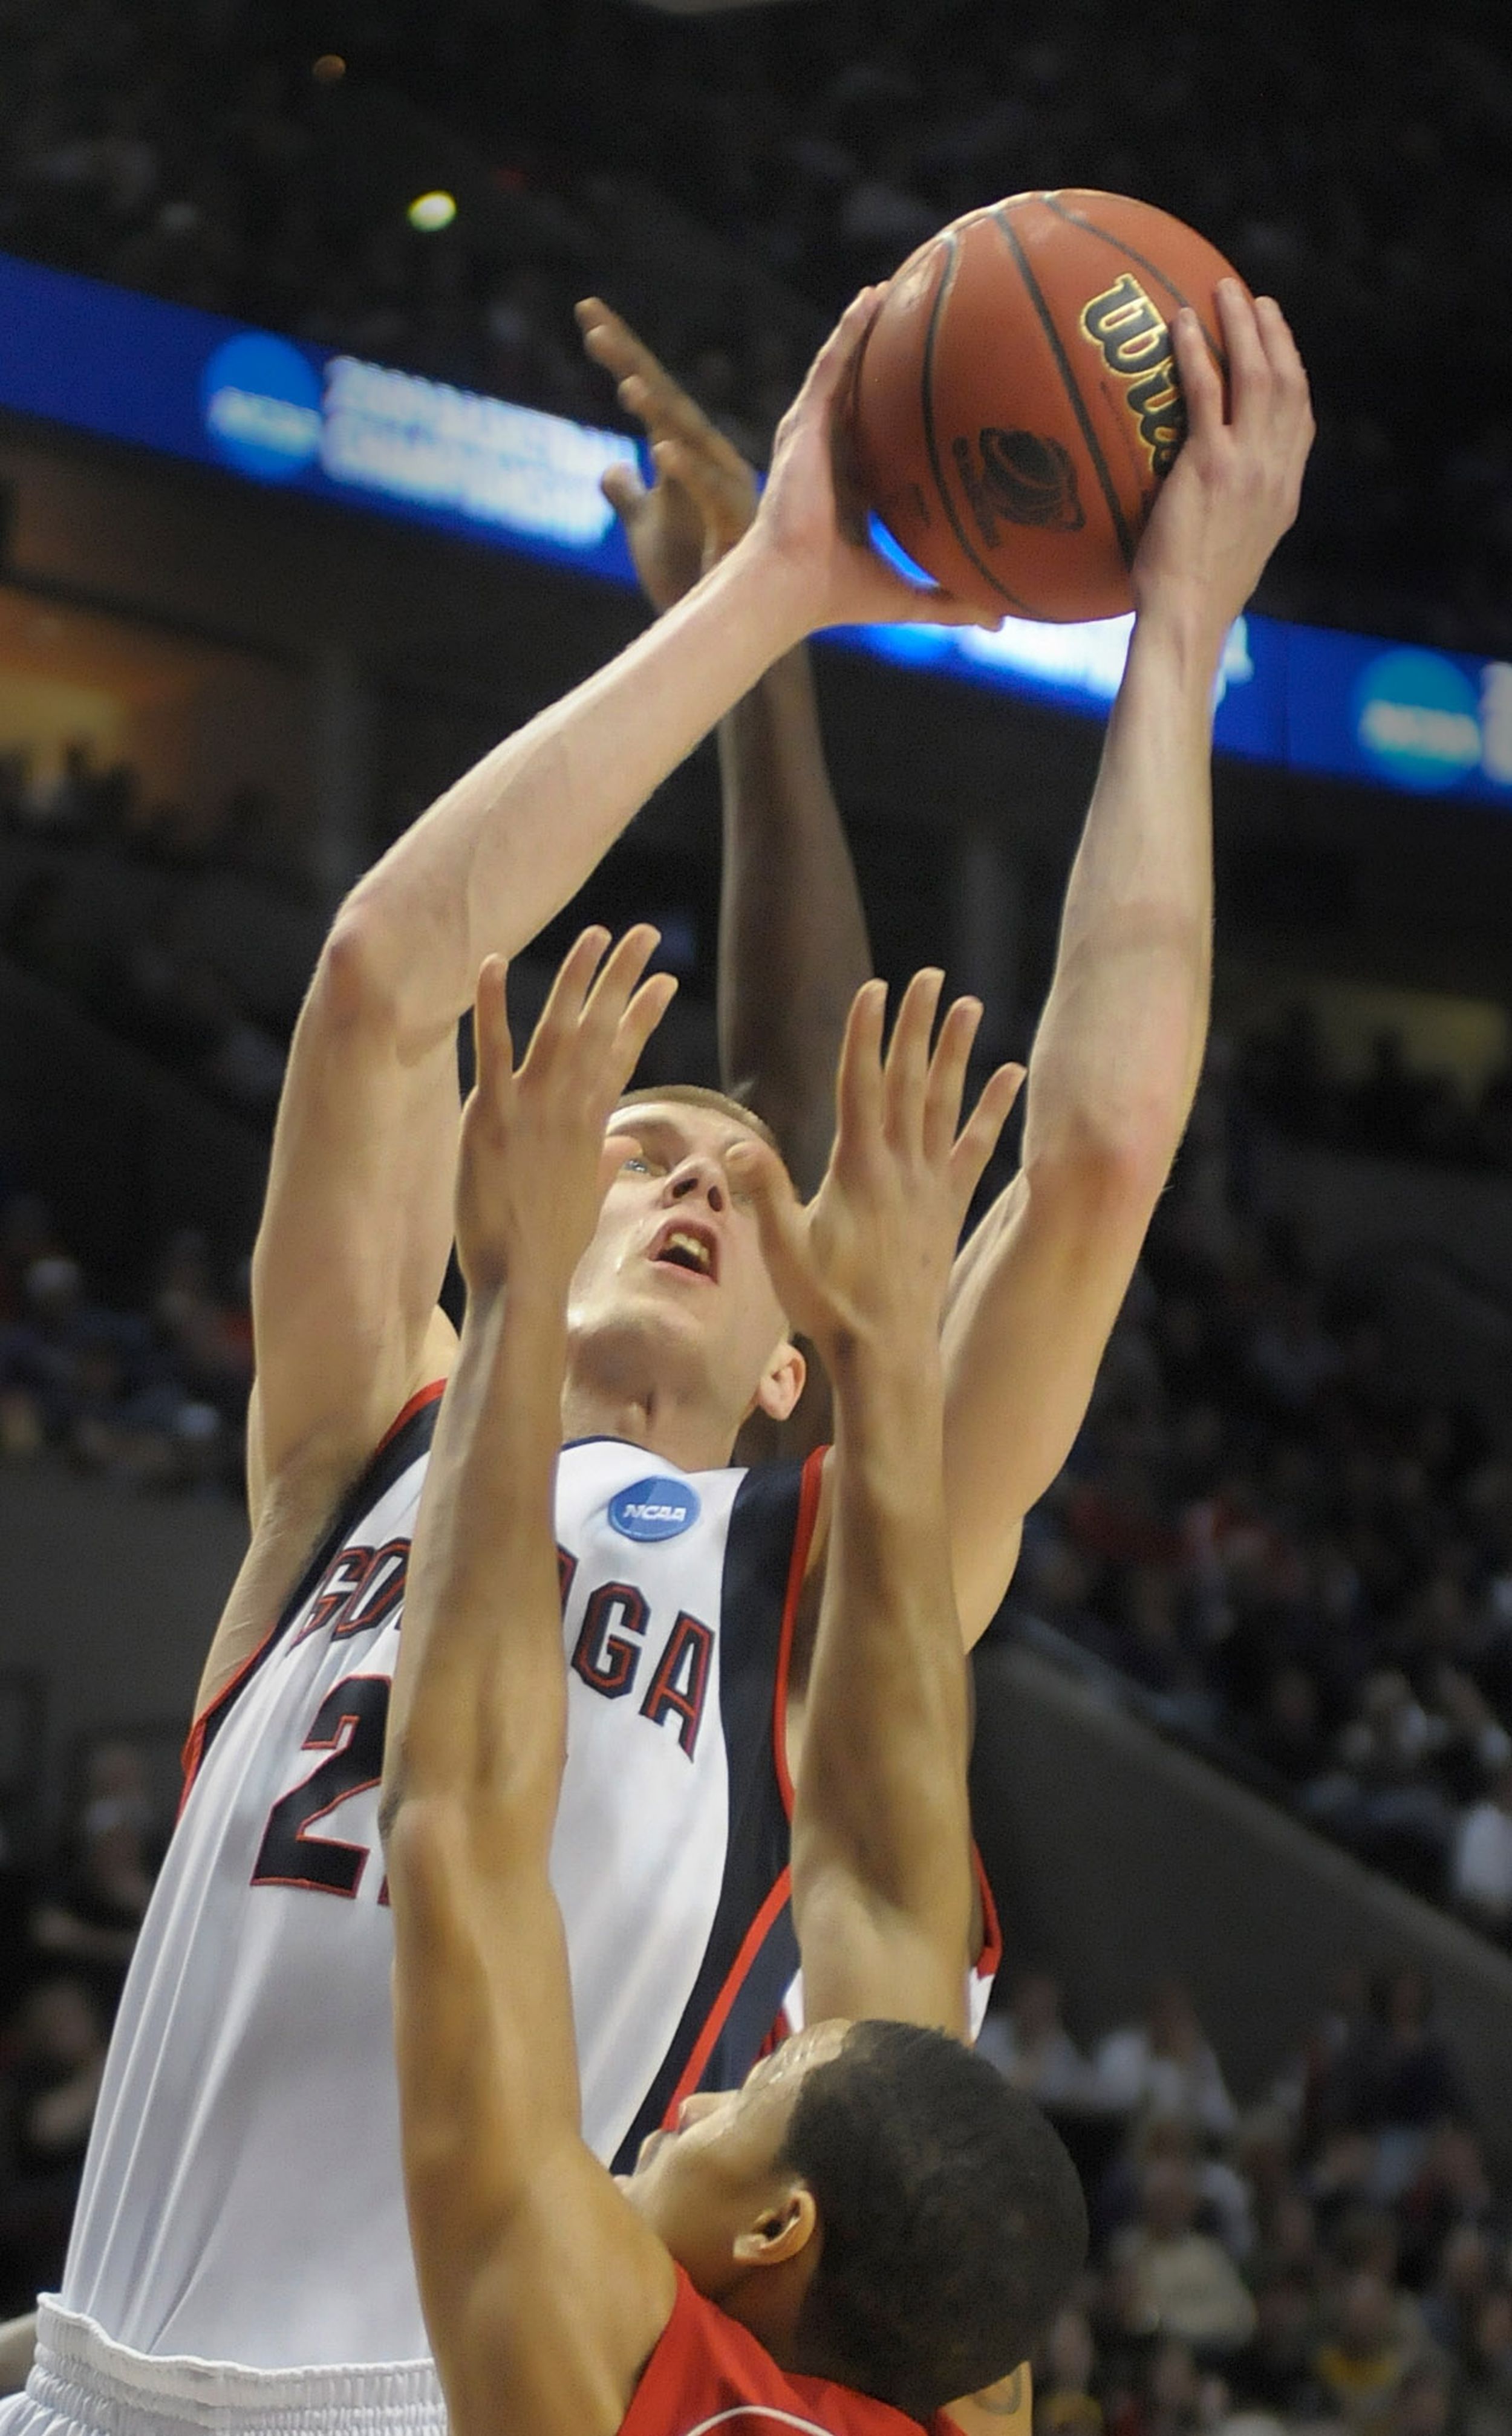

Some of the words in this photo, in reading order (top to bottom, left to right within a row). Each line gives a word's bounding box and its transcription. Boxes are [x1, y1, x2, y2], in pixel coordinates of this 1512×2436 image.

[623, 1503, 686, 1522] NCAA
[285, 1536, 715, 1763] GOGA
[250, 1674, 391, 1906] 2
